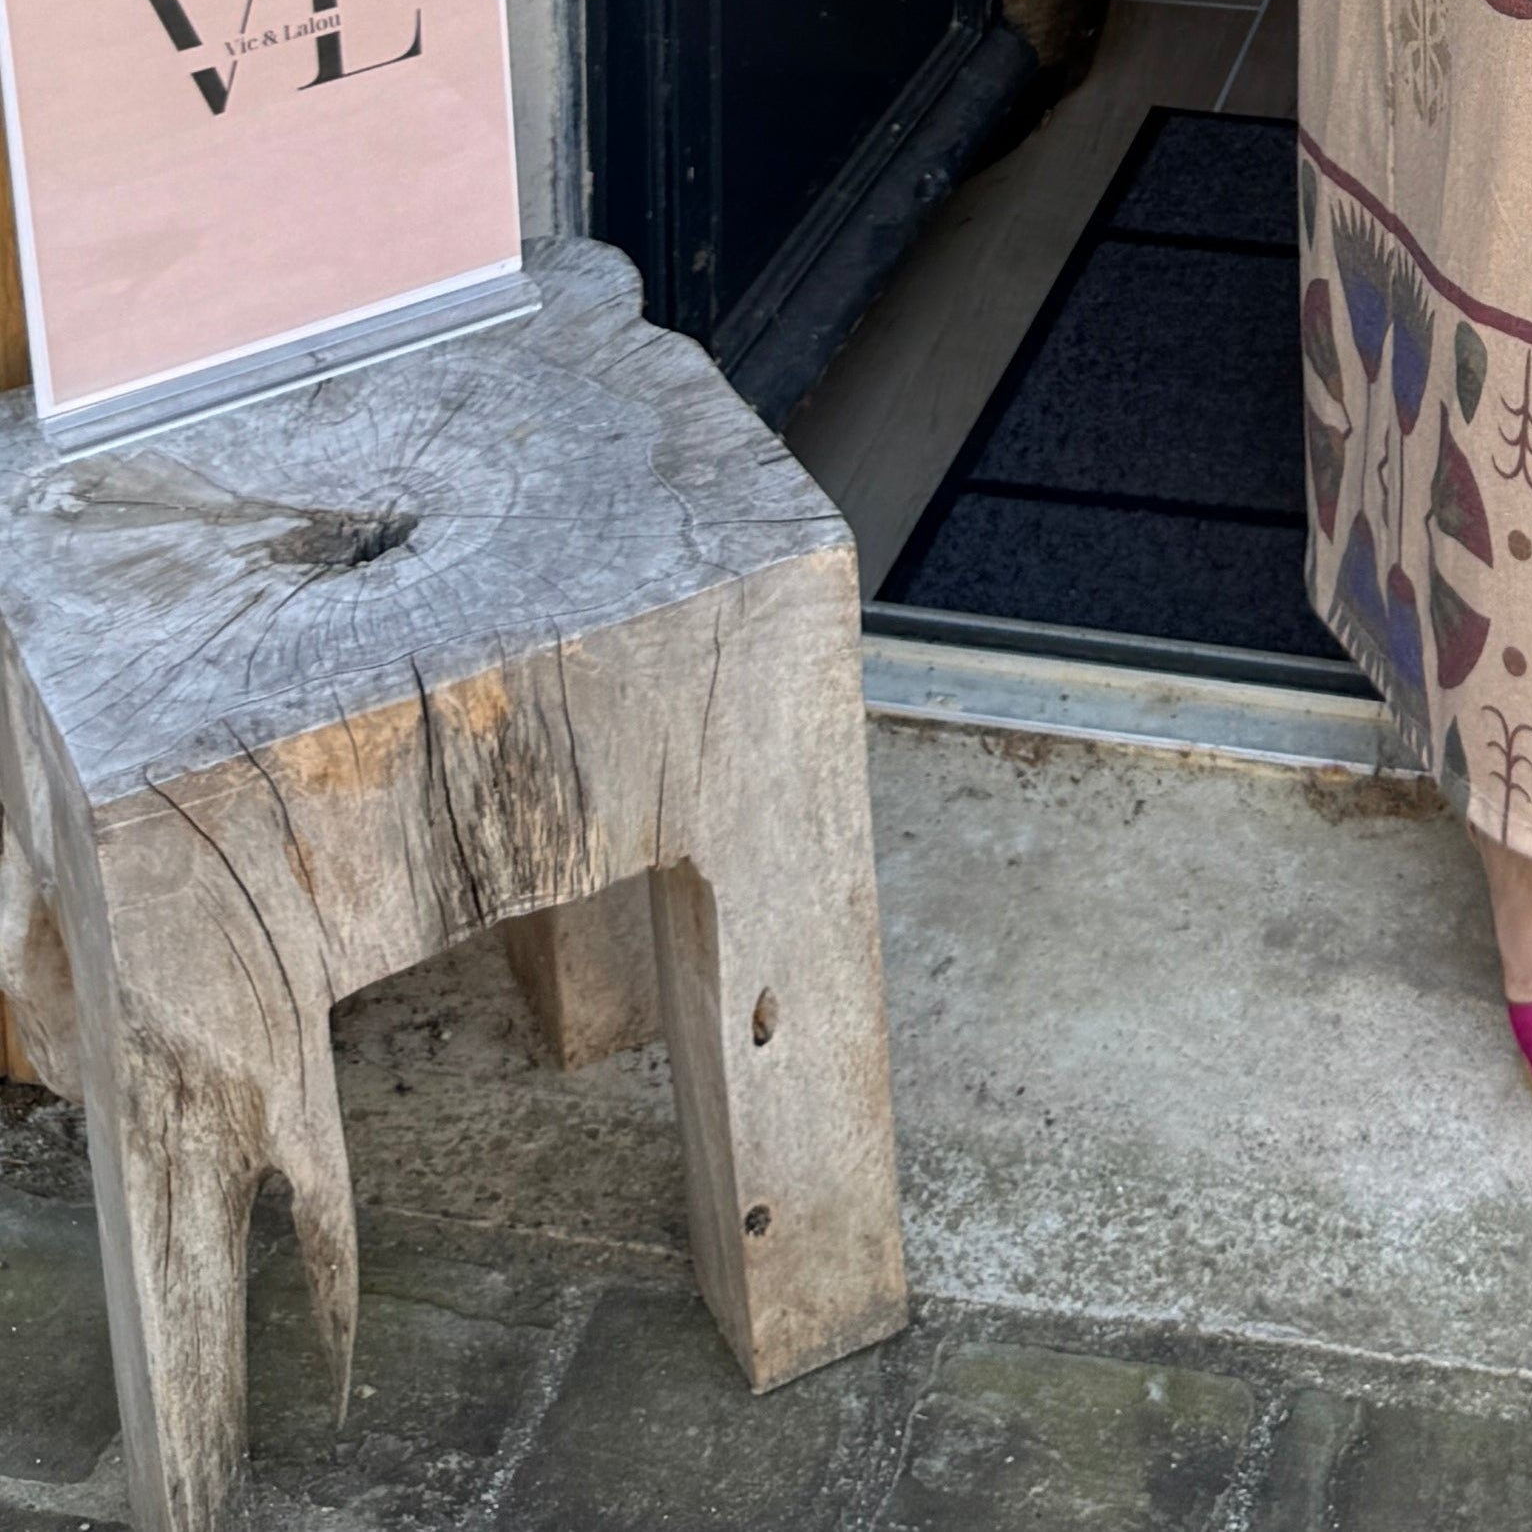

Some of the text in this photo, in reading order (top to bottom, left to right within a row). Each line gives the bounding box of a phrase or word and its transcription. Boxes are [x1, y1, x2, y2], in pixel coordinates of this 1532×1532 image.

[224, 14, 341, 55] Vic & Lalou
